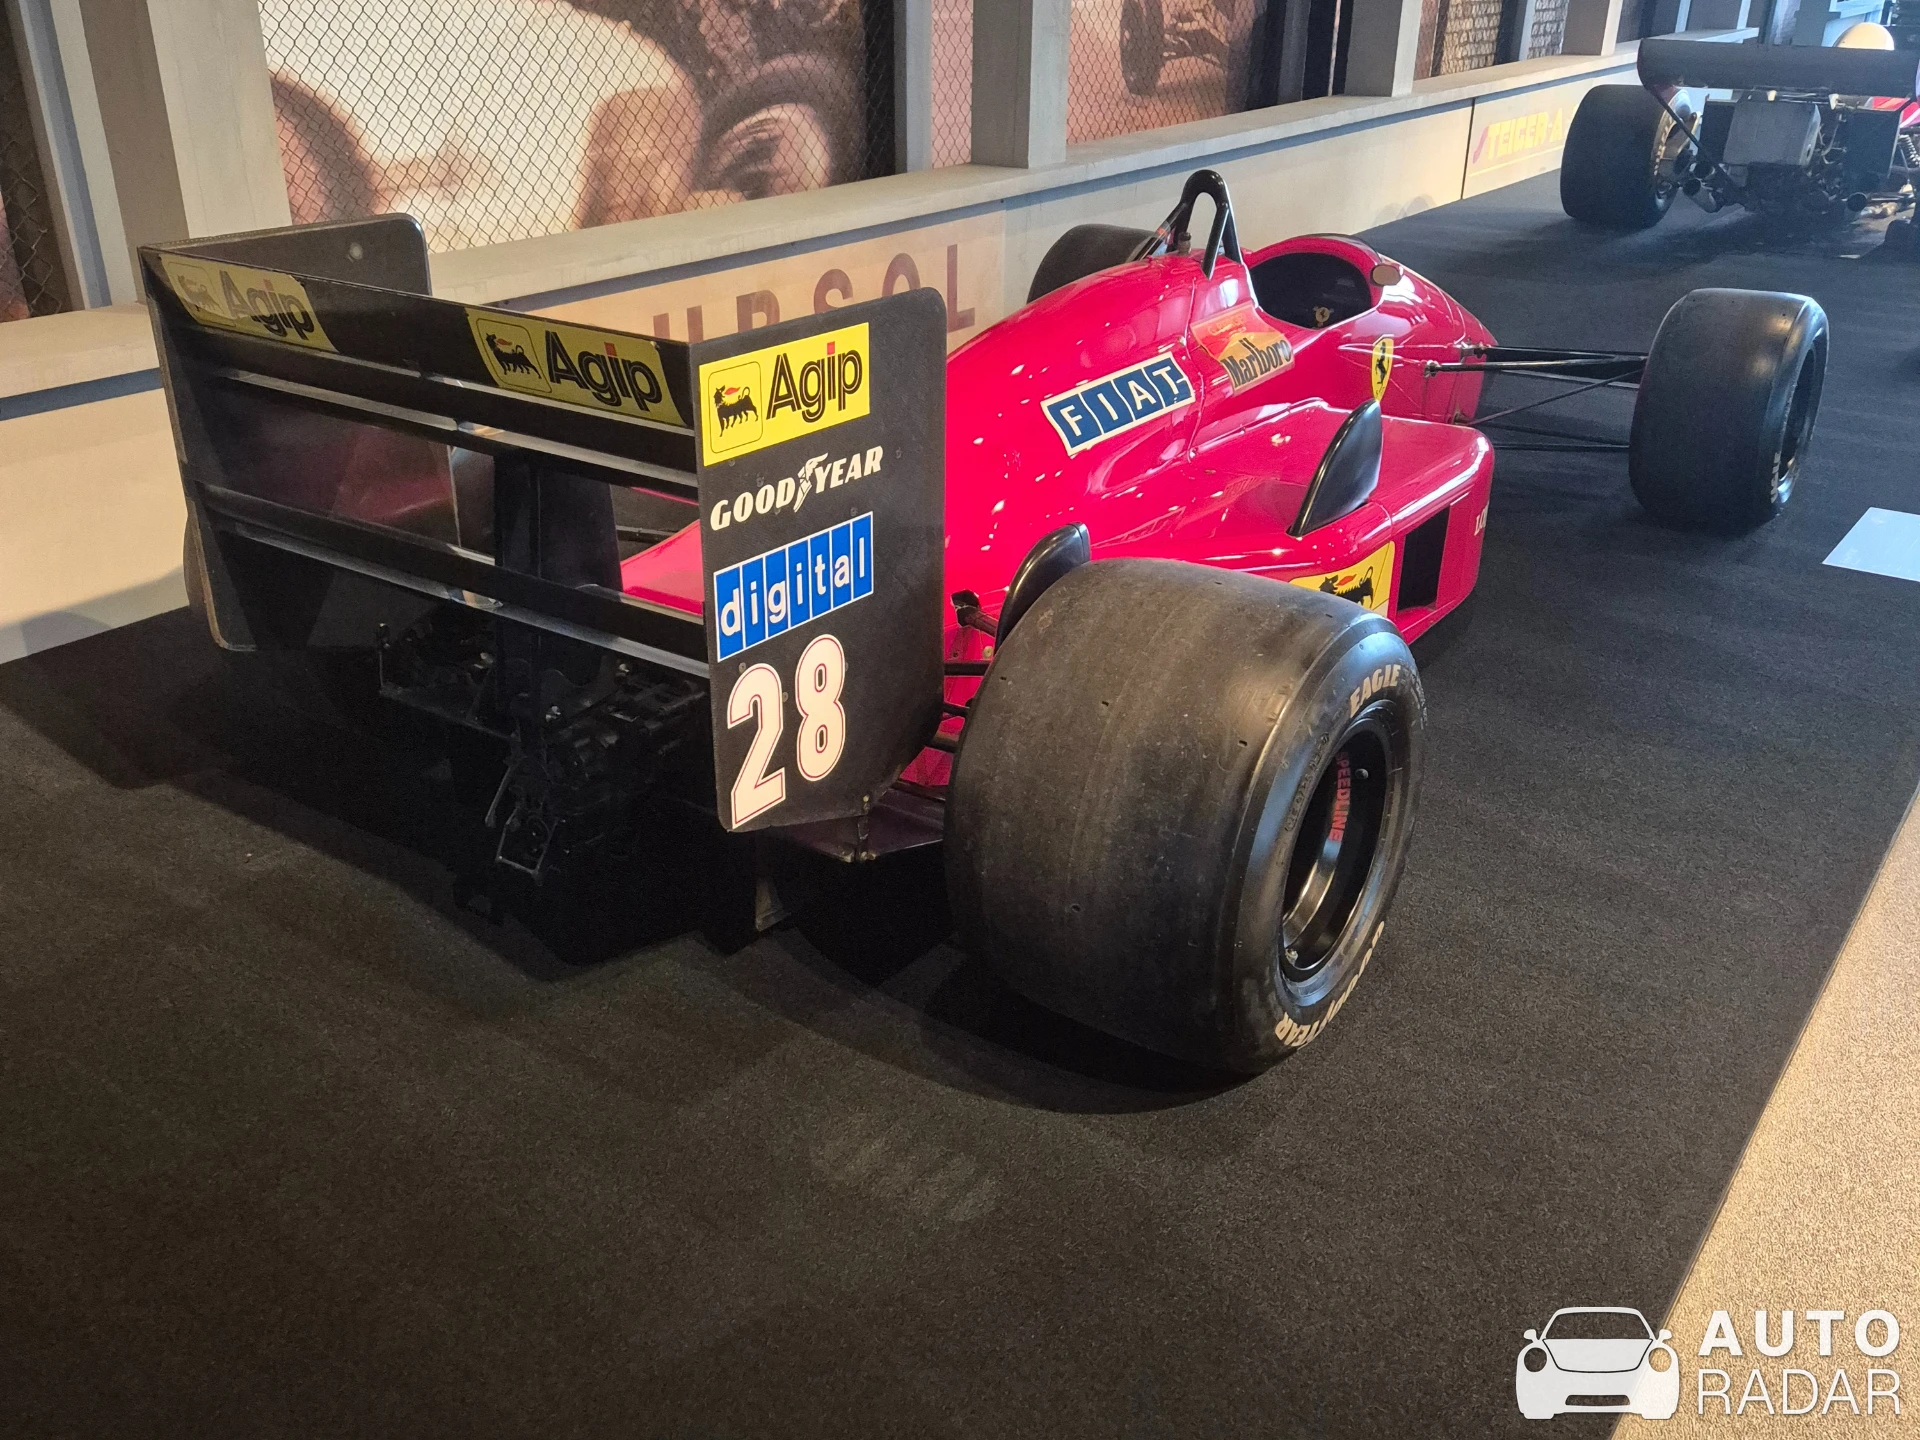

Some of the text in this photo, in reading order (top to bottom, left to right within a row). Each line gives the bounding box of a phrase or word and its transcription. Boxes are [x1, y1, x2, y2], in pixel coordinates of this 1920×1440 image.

[219, 269, 315, 341] Agip
[545, 330, 662, 411] Agip
[767, 341, 862, 423] Agip
[1059, 366, 1181, 436] FIAT
[1220, 337, 1292, 388] Marlboro
[720, 538, 865, 636] digital
[1350, 663, 1402, 718] EAGLE
[727, 634, 846, 829] 28
[1327, 750, 1352, 842] SPEEDLINE
